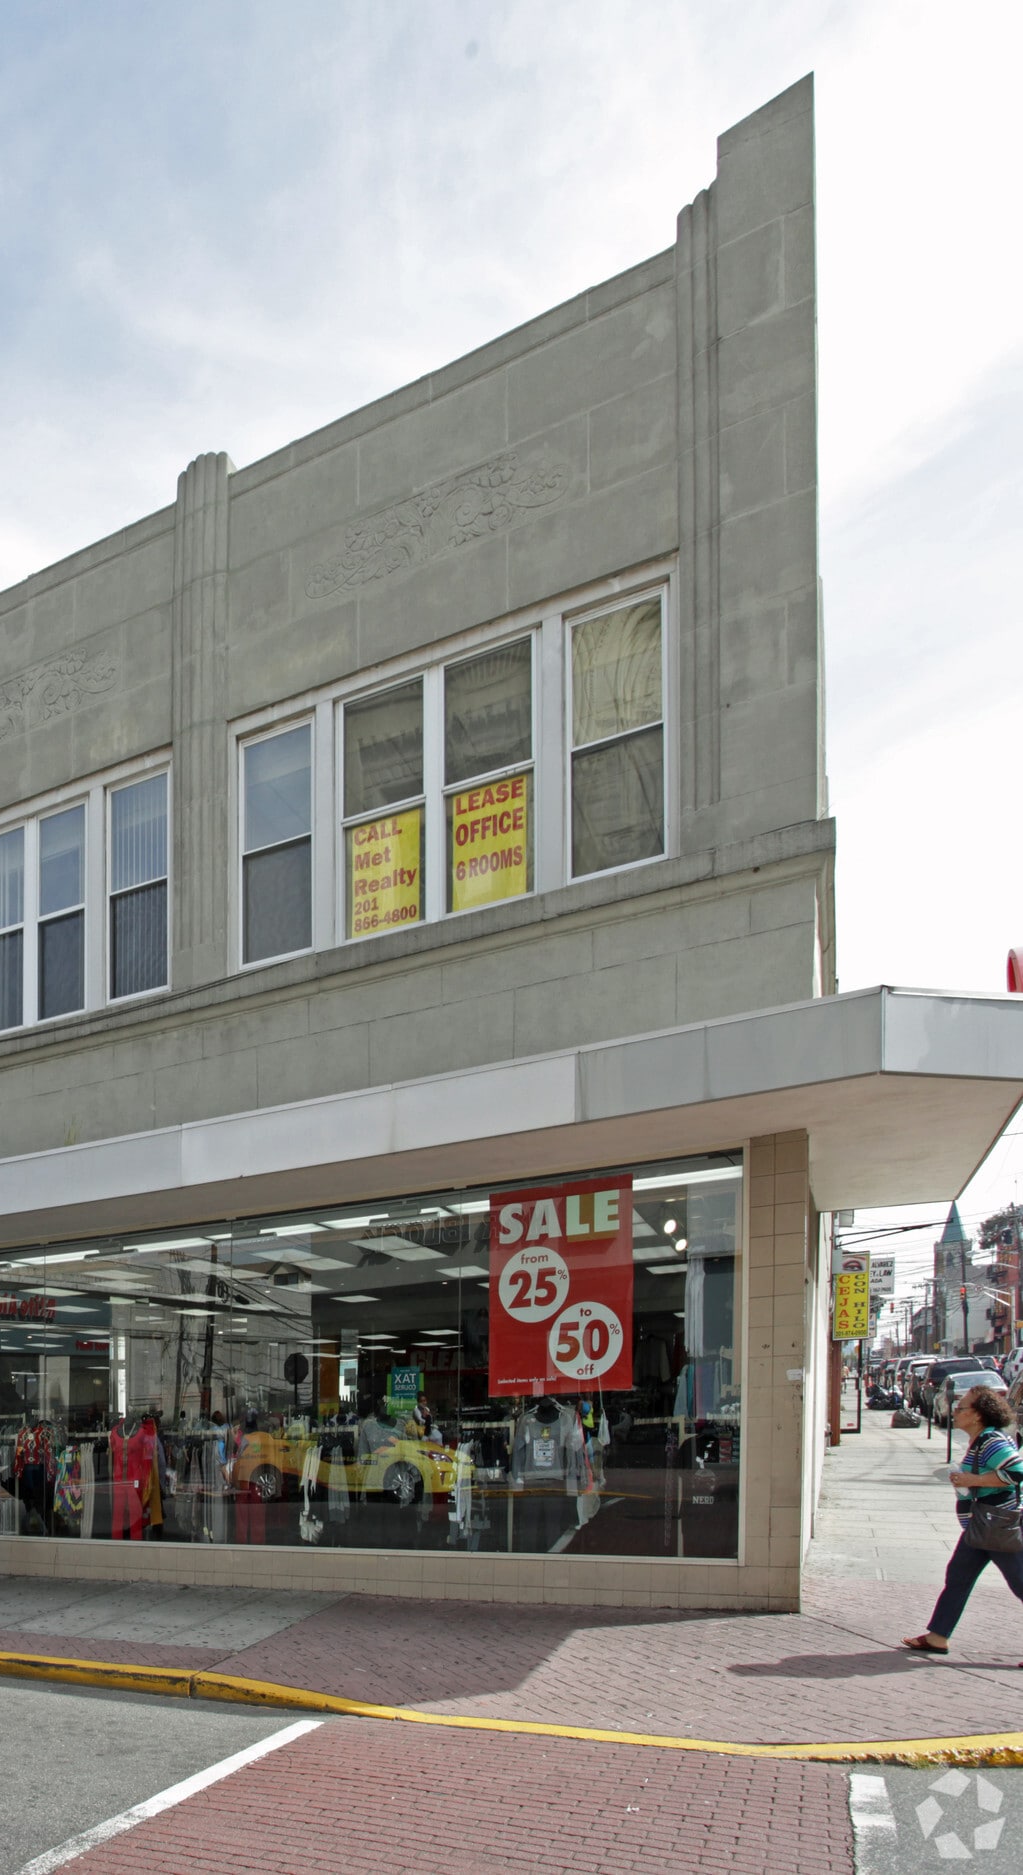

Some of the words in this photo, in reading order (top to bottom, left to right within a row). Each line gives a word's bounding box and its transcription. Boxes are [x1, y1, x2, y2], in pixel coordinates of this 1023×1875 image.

[455, 778, 524, 816] LEASE
[354, 817, 403, 846] CALL
[455, 807, 524, 846] OFFICE
[354, 846, 391, 872] Met
[455, 861, 466, 881] 6
[468, 845, 523, 877] ROOMS
[354, 867, 417, 897] Realty
[354, 898, 380, 916] 201
[354, 904, 417, 933] 866-4800
[498, 1188, 621, 1244] SALE
[520, 1253, 549, 1264] from
[508, 1267, 568, 1310] 25%
[838, 1275, 851, 1330] CEJAS
[579, 1307, 592, 1317] to
[555, 1319, 621, 1363] 50%
[576, 1363, 595, 1376] off
[692, 1495, 715, 1505] NERD
